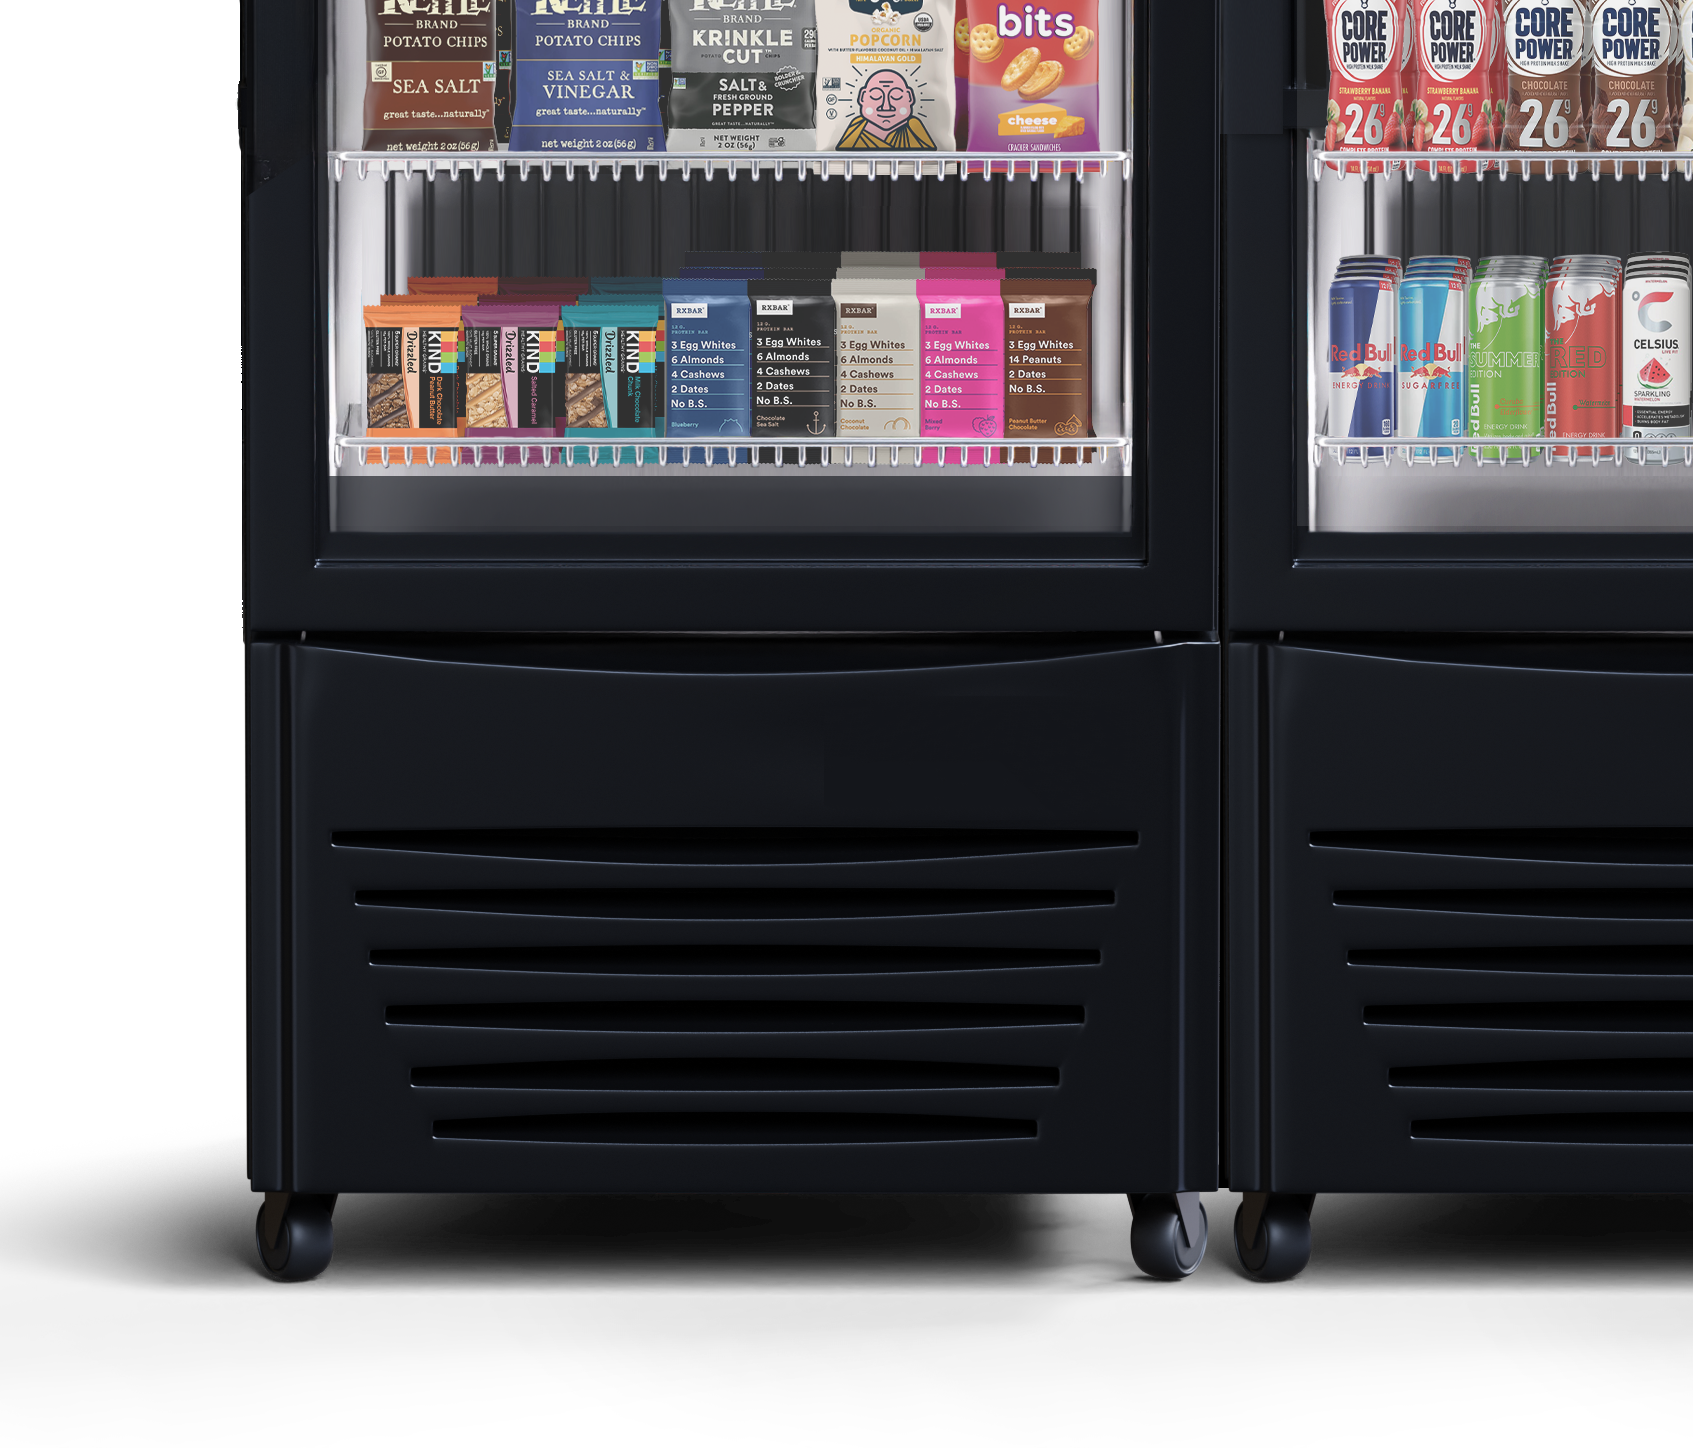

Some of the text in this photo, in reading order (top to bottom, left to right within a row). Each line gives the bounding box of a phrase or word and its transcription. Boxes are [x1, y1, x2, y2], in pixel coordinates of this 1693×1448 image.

[998, 5, 1074, 37] bits
[1341, 10, 1388, 41] CORE
[1516, 7, 1573, 37] CORE
[693, 30, 793, 46] KRINKLE
[850, 34, 921, 46] POPCORN
[723, 49, 763, 64] CUT
[1343, 42, 1386, 63] POWER
[1516, 39, 1572, 59] POWER
[393, 79, 480, 93] SEA SALT
[1522, 81, 1568, 90] CHOCOLATE
[713, 104, 773, 116] PEPPER
[1008, 115, 1057, 126] cheese
[676, 307, 704, 315] RXBAR
[428, 331, 441, 373] KIND
[671, 340, 736, 351] 3 Egg Whites
[1401, 342, 1462, 362] Red Bull
[1634, 339, 1679, 350] CELSIUS
[1331, 343, 1392, 362] Red Bull
[1550, 346, 1607, 368] RED
[1550, 370, 1585, 378] EDITION
